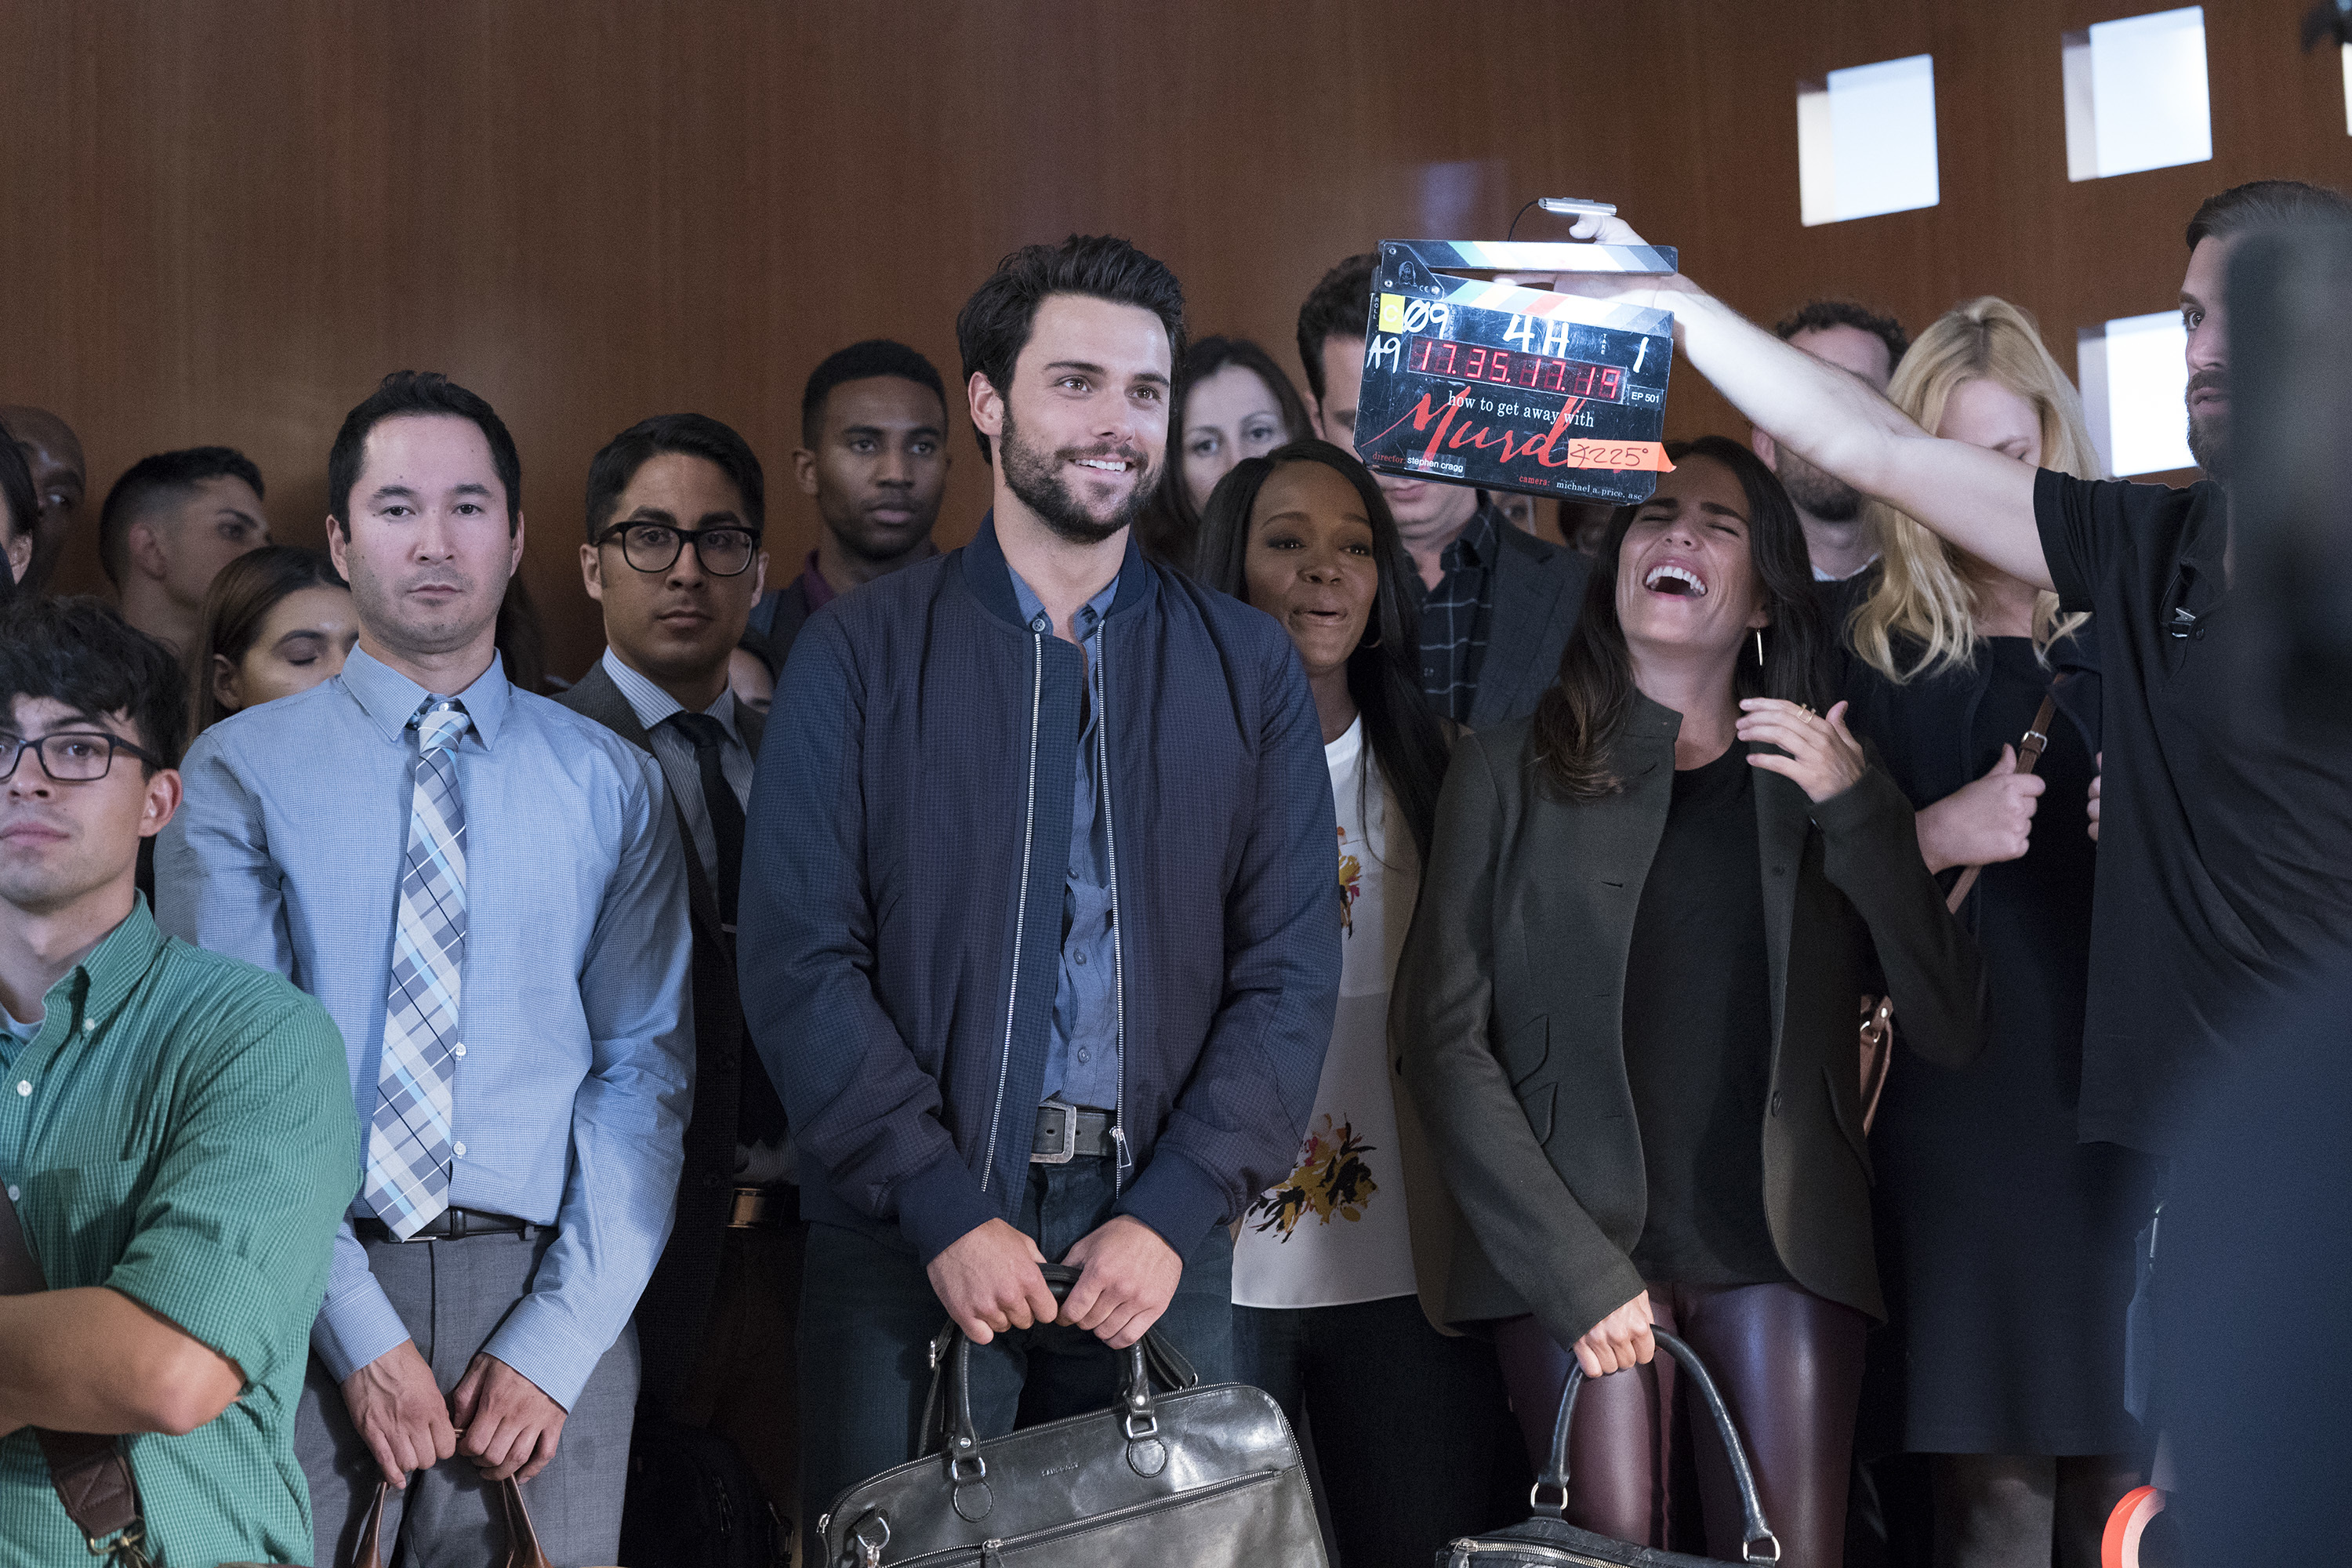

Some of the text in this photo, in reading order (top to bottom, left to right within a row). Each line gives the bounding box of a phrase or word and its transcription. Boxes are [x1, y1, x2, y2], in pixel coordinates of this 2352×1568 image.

[1383, 304, 1399, 323] C
[1366, 334, 1401, 374] A9
[1631, 391, 1660, 404] EP 501
[1448, 390, 1595, 428] how to get away with
[1360, 385, 1621, 474] Murd
[1406, 457, 1439, 469] stephen
[1440, 463, 1464, 473] cragg
[1519, 475, 1550, 486] camera:
[1556, 481, 1590, 493] michael
